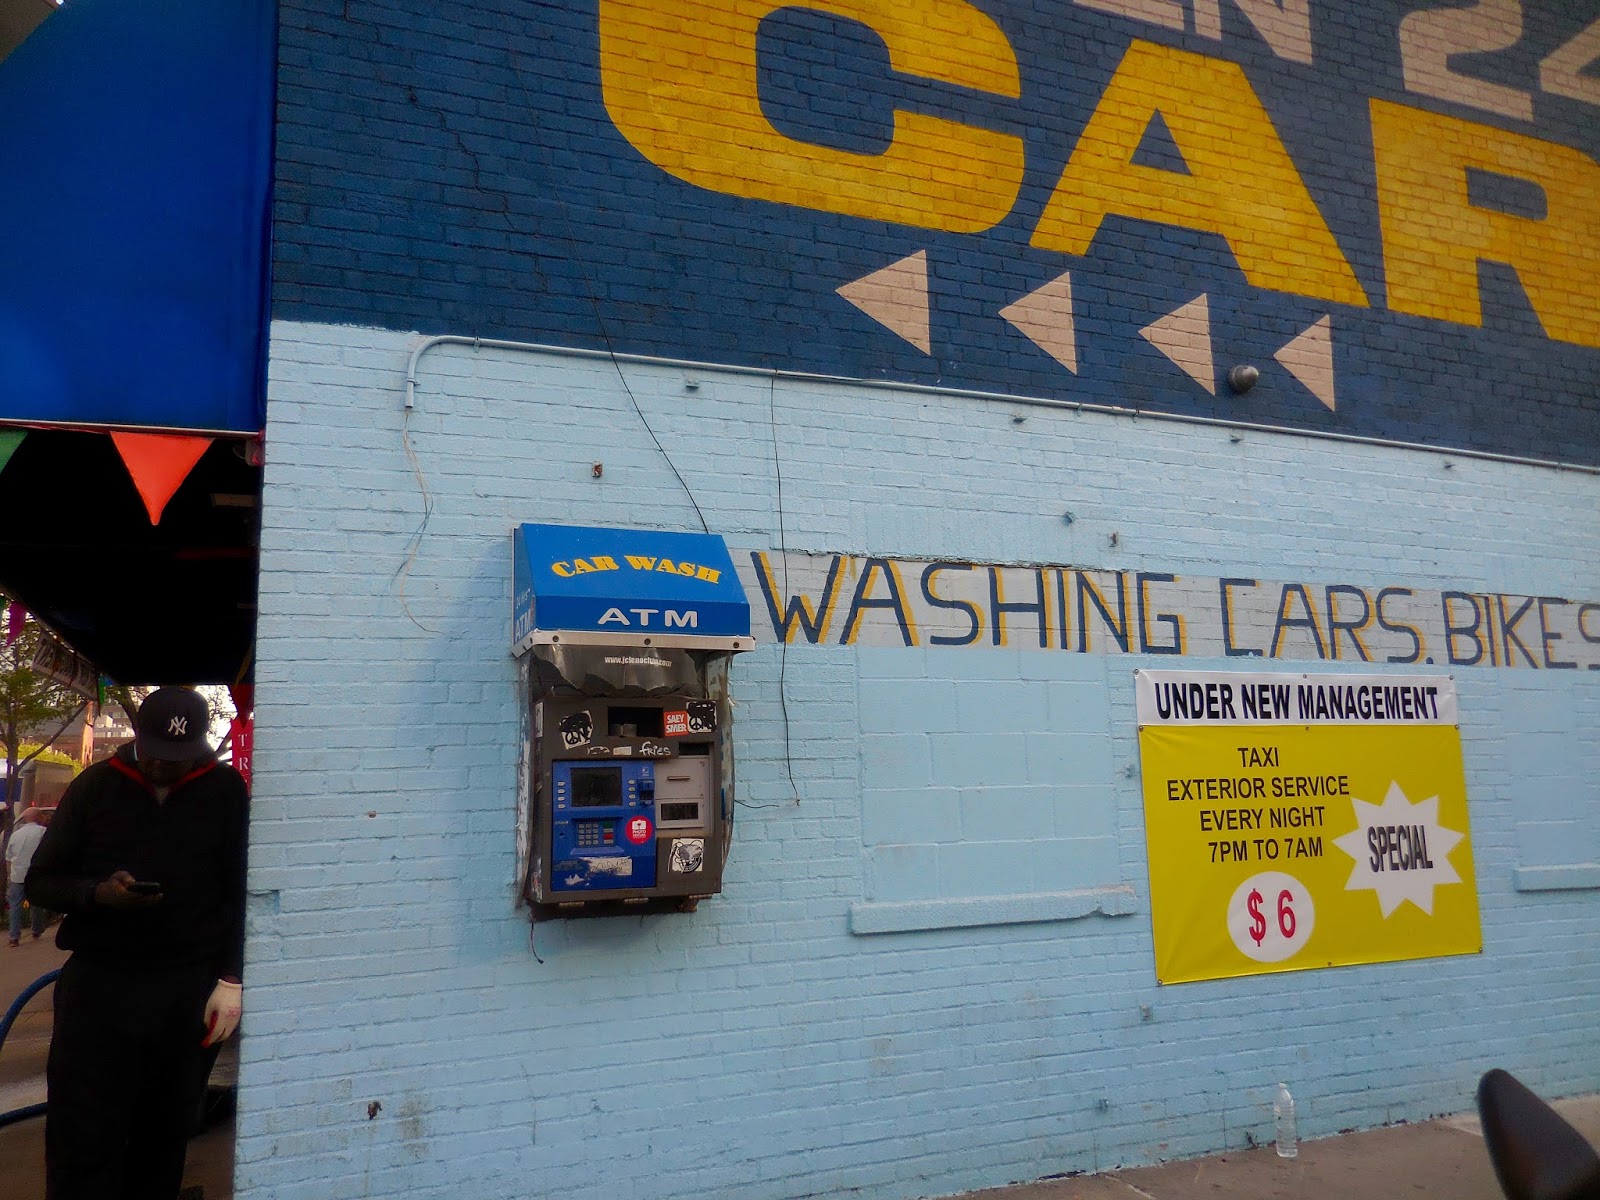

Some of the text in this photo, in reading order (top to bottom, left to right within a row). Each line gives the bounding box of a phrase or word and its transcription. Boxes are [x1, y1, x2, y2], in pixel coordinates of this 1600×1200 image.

[599, 0, 1600, 348] CAR
[551, 555, 722, 584] CAR WASH
[597, 607, 698, 628] ATM
[750, 551, 1188, 655] WASHING
[1154, 682, 1438, 720] UNDER NEW MANAGEMENT
[1237, 747, 1280, 768] TAXI
[1167, 775, 1350, 801] EXTERIOR SERVICE
[1200, 806, 1326, 832] EVERY NIGHT
[1208, 836, 1324, 863] 7PM TO 7AM
[1367, 824, 1434, 873] SPECIAL
[1246, 888, 1297, 948] $ 6
